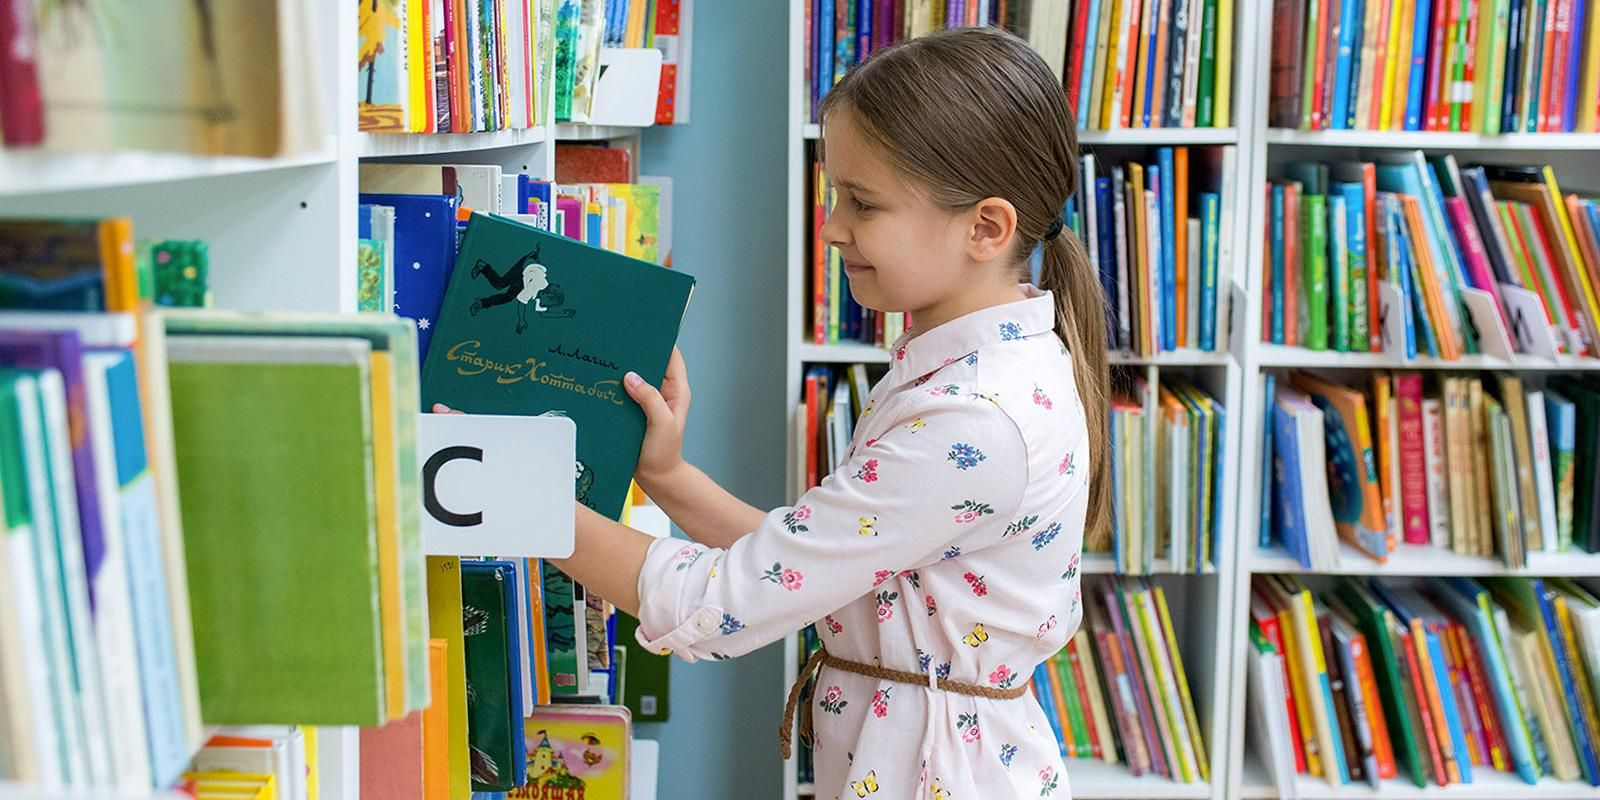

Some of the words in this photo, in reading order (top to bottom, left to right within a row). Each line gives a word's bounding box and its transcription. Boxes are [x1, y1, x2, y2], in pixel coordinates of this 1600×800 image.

[447, 339, 522, 376] Старик
[496, 357, 624, 405] Хоттабыч
[567, 348, 619, 371] Лагин
